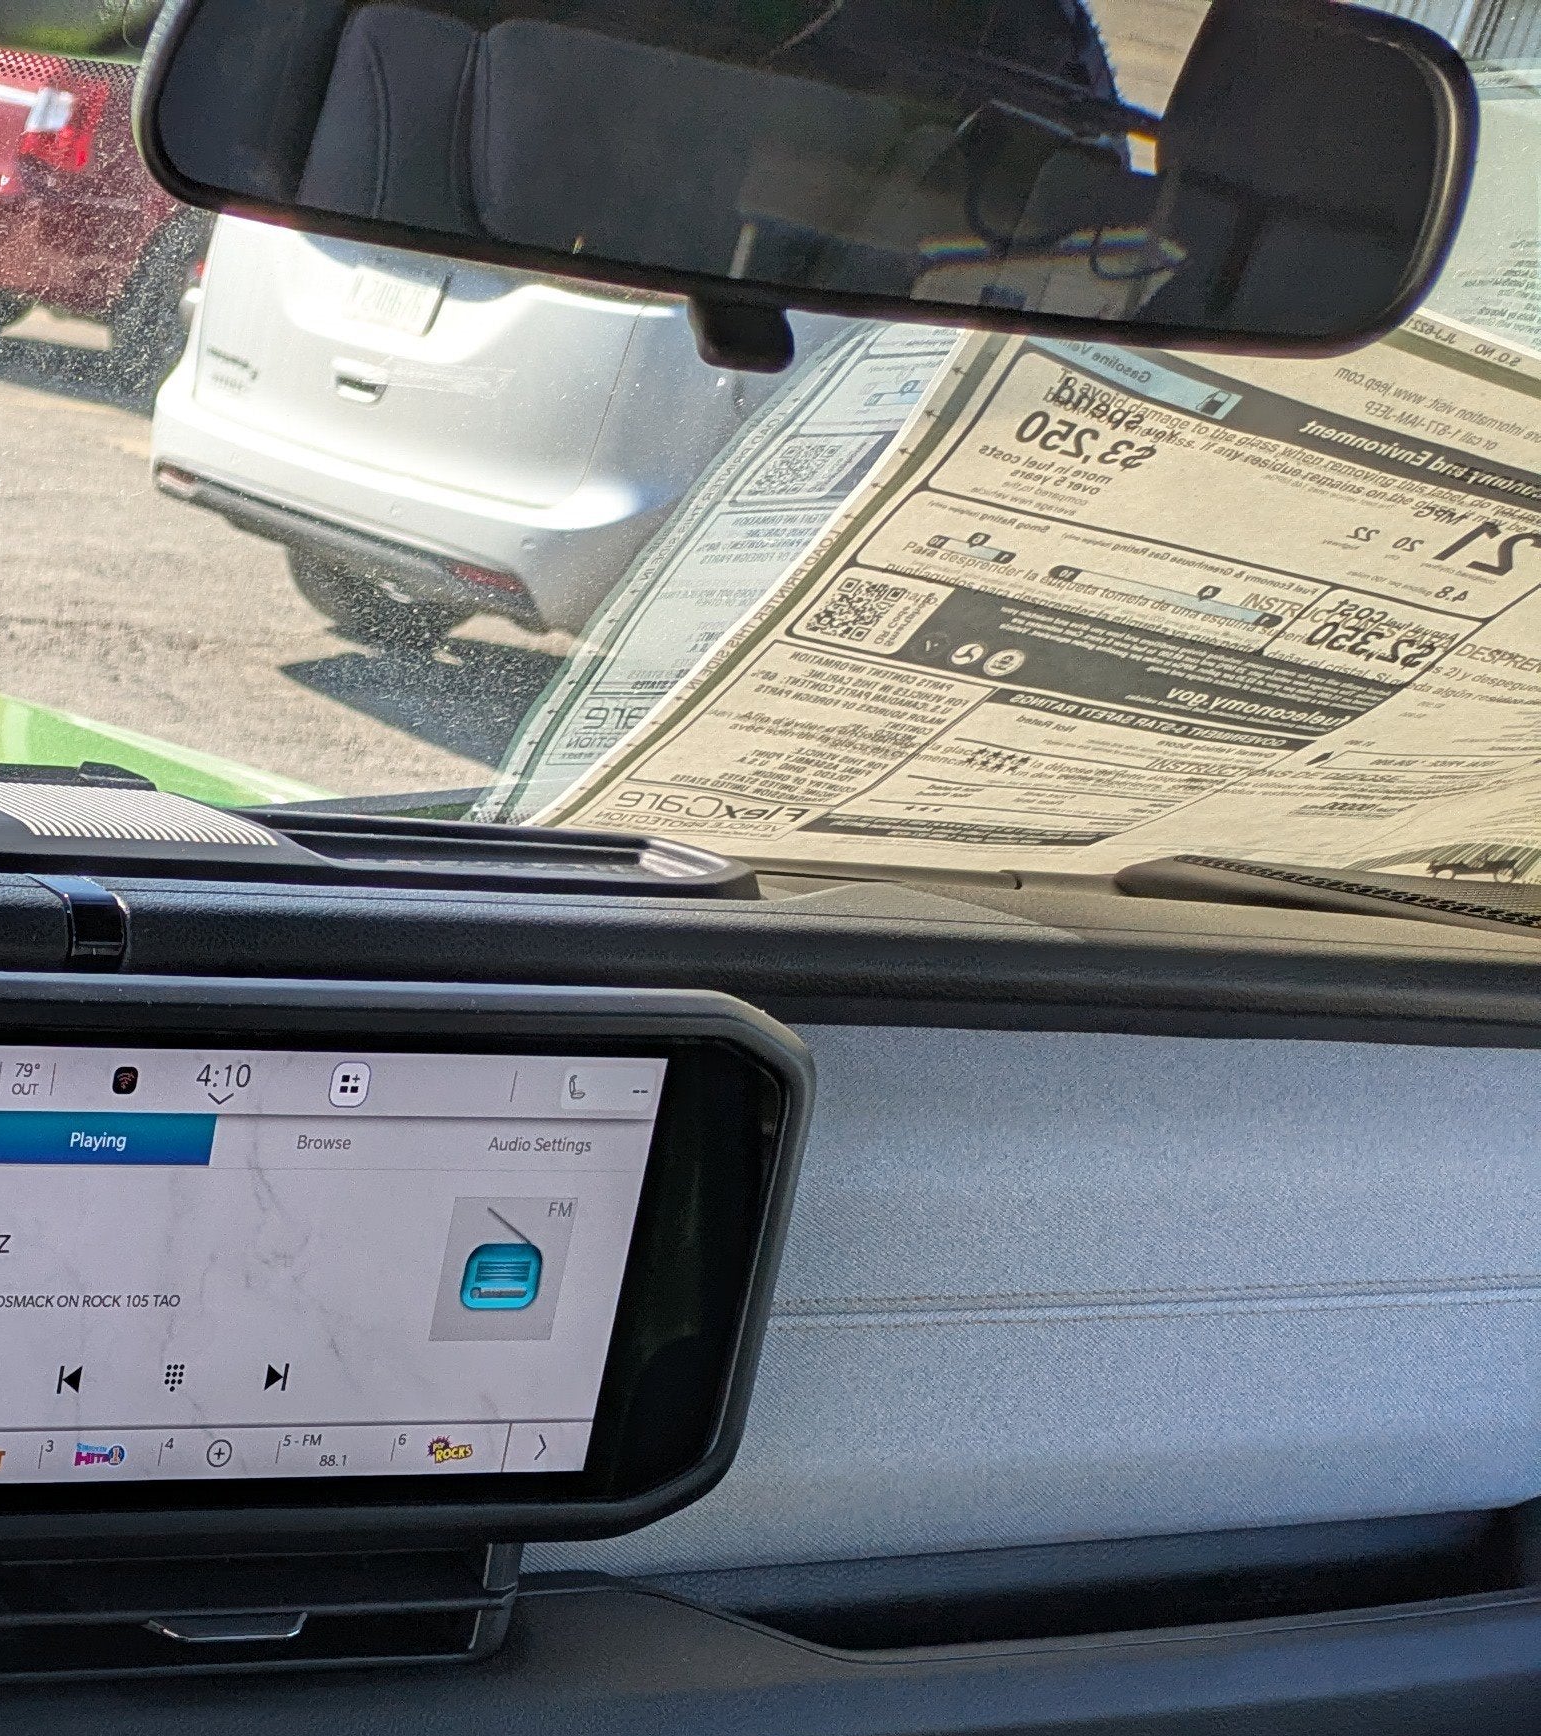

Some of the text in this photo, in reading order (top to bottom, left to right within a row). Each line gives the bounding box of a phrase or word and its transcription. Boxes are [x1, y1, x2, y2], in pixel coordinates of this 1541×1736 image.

[196, 1064, 251, 1088] 4:10
[12, 1083, 38, 1095] OUT
[70, 1132, 126, 1150] Playing
[297, 1135, 351, 1150] Browse
[488, 1137, 592, 1154] Audio Settings
[548, 1202, 572, 1217] FM
[57, 1295, 79, 1308] ON
[82, 1295, 120, 1308] ROCK
[126, 1295, 149, 1307] 105
[153, 1295, 180, 1307] TAO
[319, 1455, 347, 1467] 88.1
